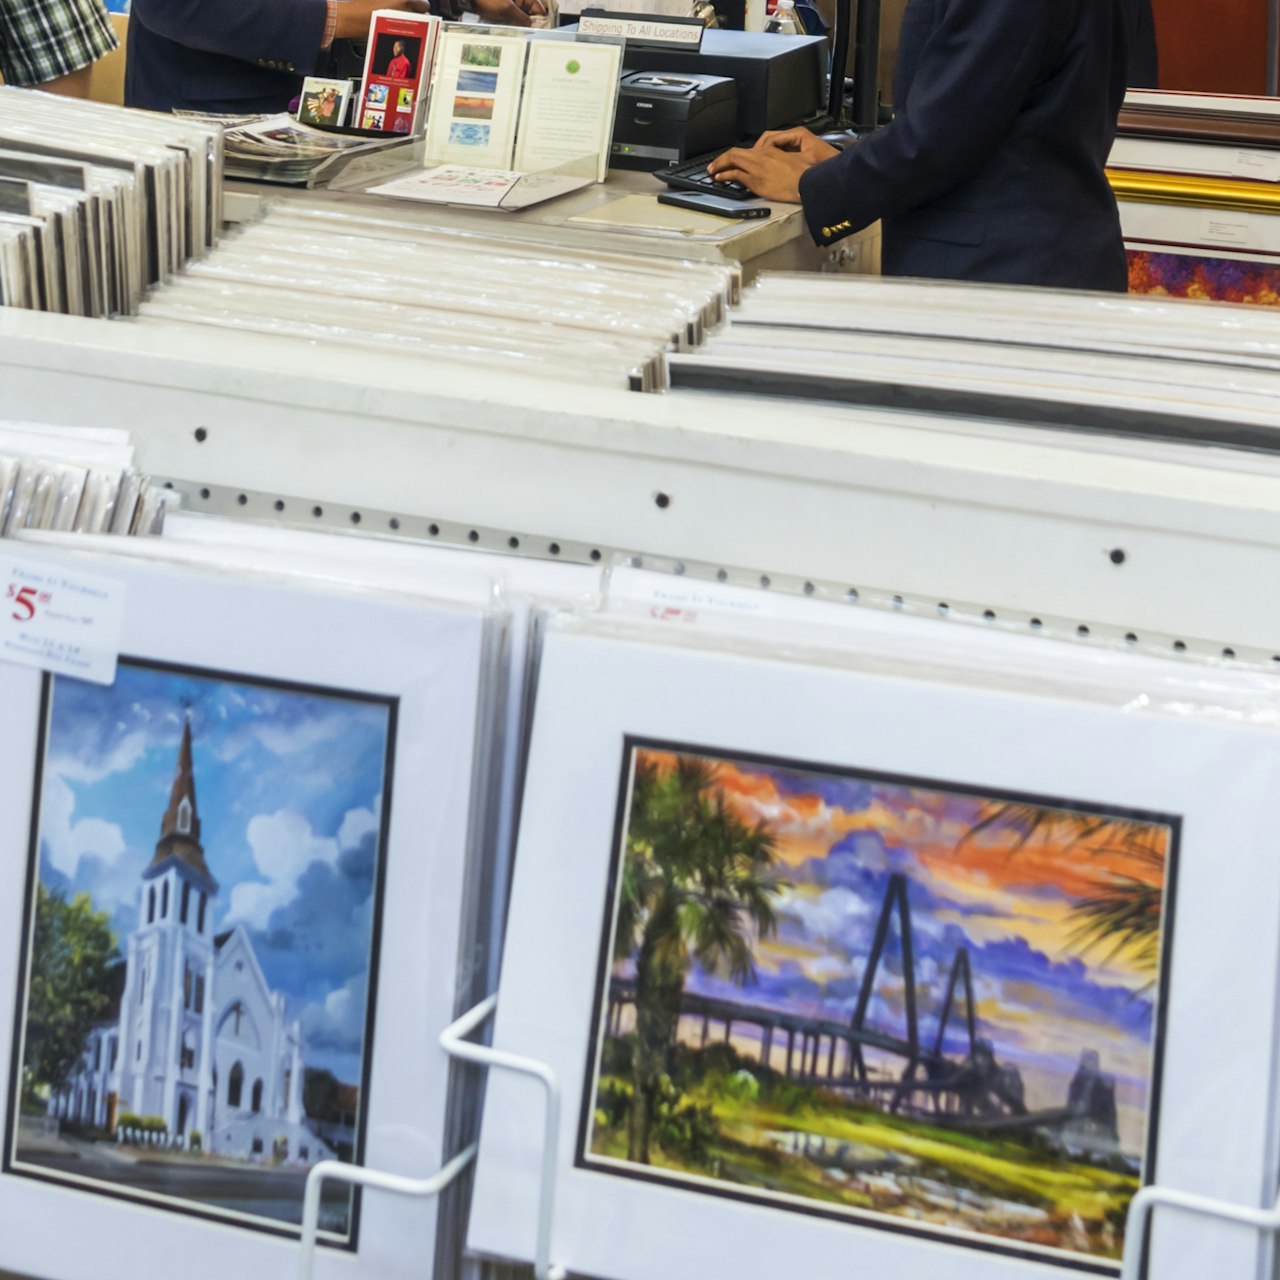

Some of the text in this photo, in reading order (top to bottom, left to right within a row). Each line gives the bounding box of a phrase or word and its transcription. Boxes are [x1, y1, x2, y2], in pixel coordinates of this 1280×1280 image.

[582, 20, 698, 40] Shipping To All Locations
